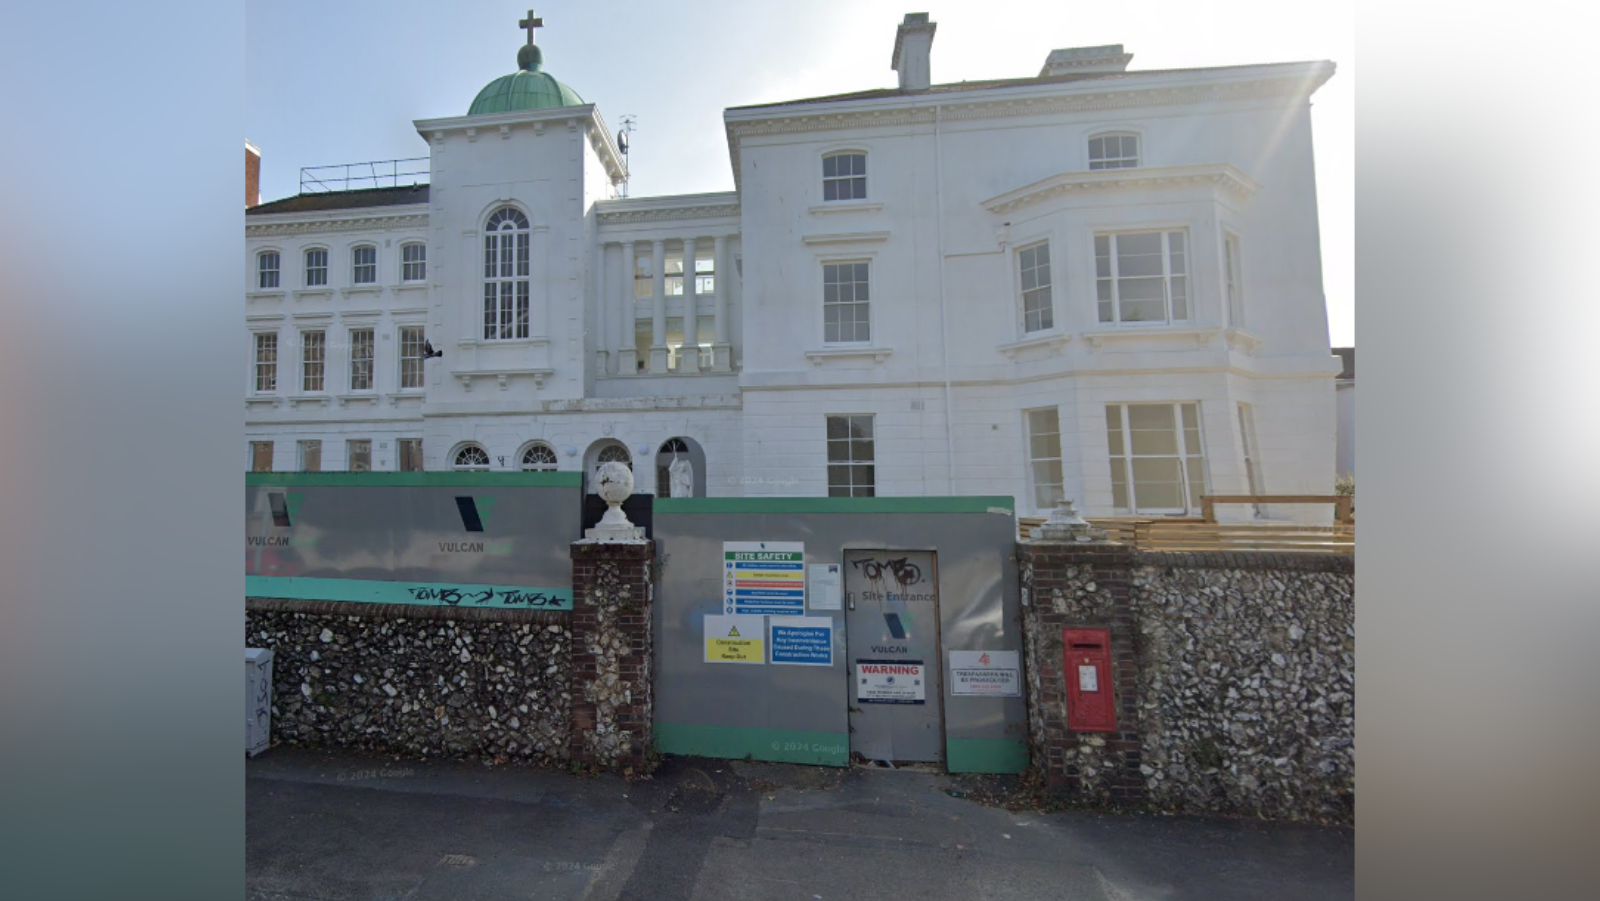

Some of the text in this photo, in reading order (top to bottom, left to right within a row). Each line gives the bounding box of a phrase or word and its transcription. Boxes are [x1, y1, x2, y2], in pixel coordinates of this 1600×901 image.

[247, 536, 289, 546] VULCAN
[438, 542, 484, 553] VULCAN
[734, 552, 793, 560] SITE SAFETY
[861, 591, 936, 601] Site Entrance
[871, 646, 907, 654] VULCAN
[861, 665, 919, 675] WARNING
